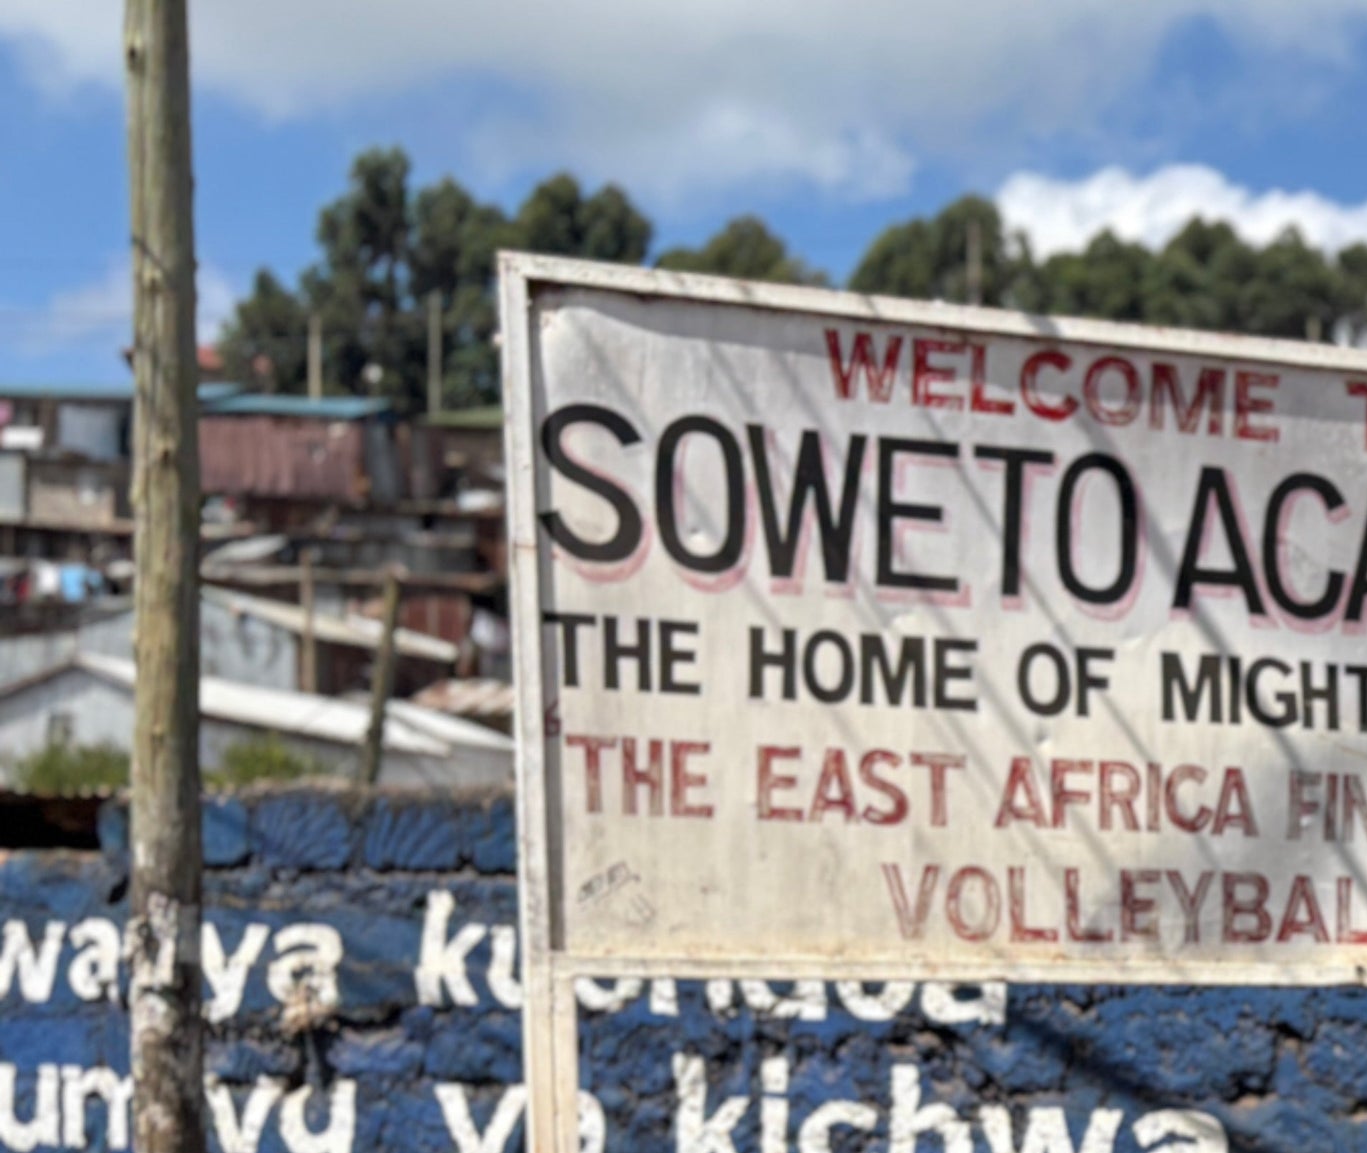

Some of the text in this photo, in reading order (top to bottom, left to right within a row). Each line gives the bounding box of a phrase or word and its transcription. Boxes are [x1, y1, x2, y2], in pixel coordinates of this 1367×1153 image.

[824, 327, 1280, 442] WELCOME
[538, 403, 1145, 612] SOWETO
[542, 611, 701, 694] THE
[749, 626, 978, 711] HOME
[1017, 643, 1115, 717] OF
[757, 745, 966, 827] EAST
[994, 757, 1258, 837] AFRICA
